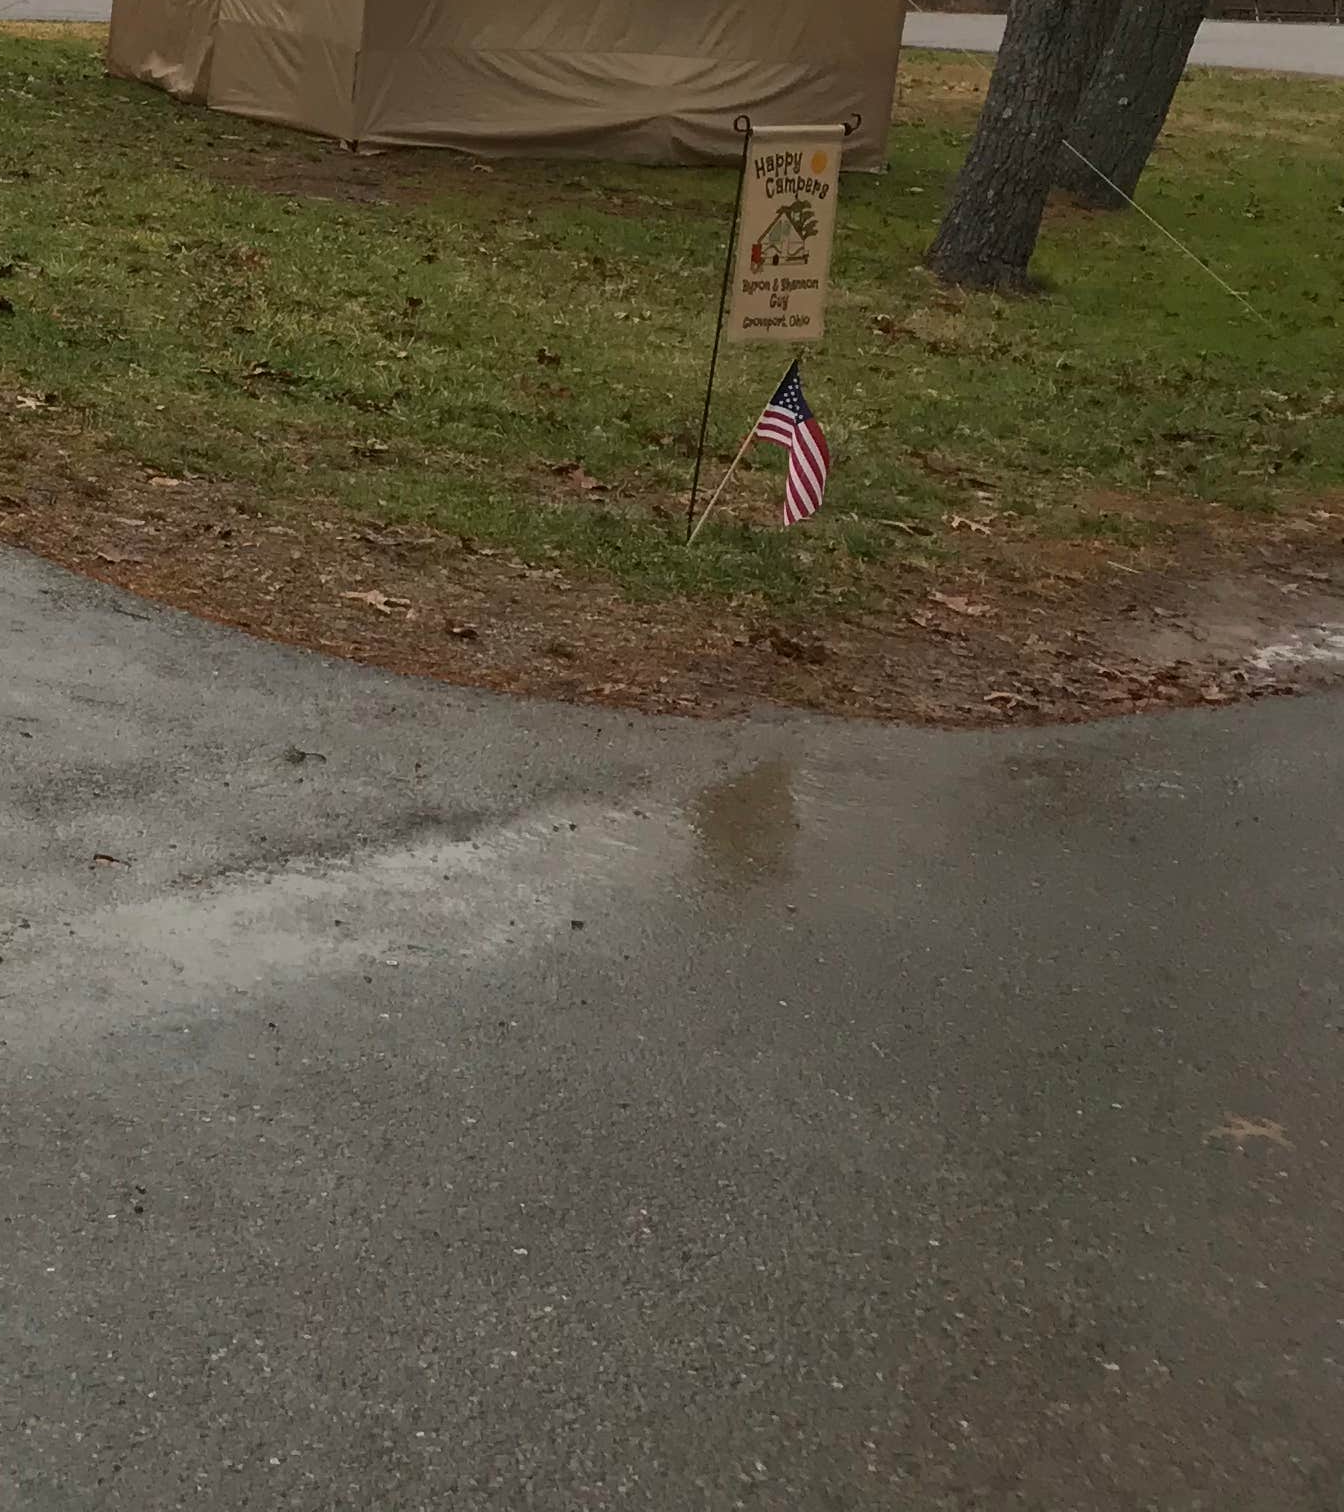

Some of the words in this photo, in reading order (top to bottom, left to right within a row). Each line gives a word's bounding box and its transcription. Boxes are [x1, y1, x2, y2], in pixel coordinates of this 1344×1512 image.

[754, 151, 803, 179] Happy
[765, 175, 830, 199] Campers
[769, 293, 789, 311] Guy
[789, 314, 810, 328] Ohio
